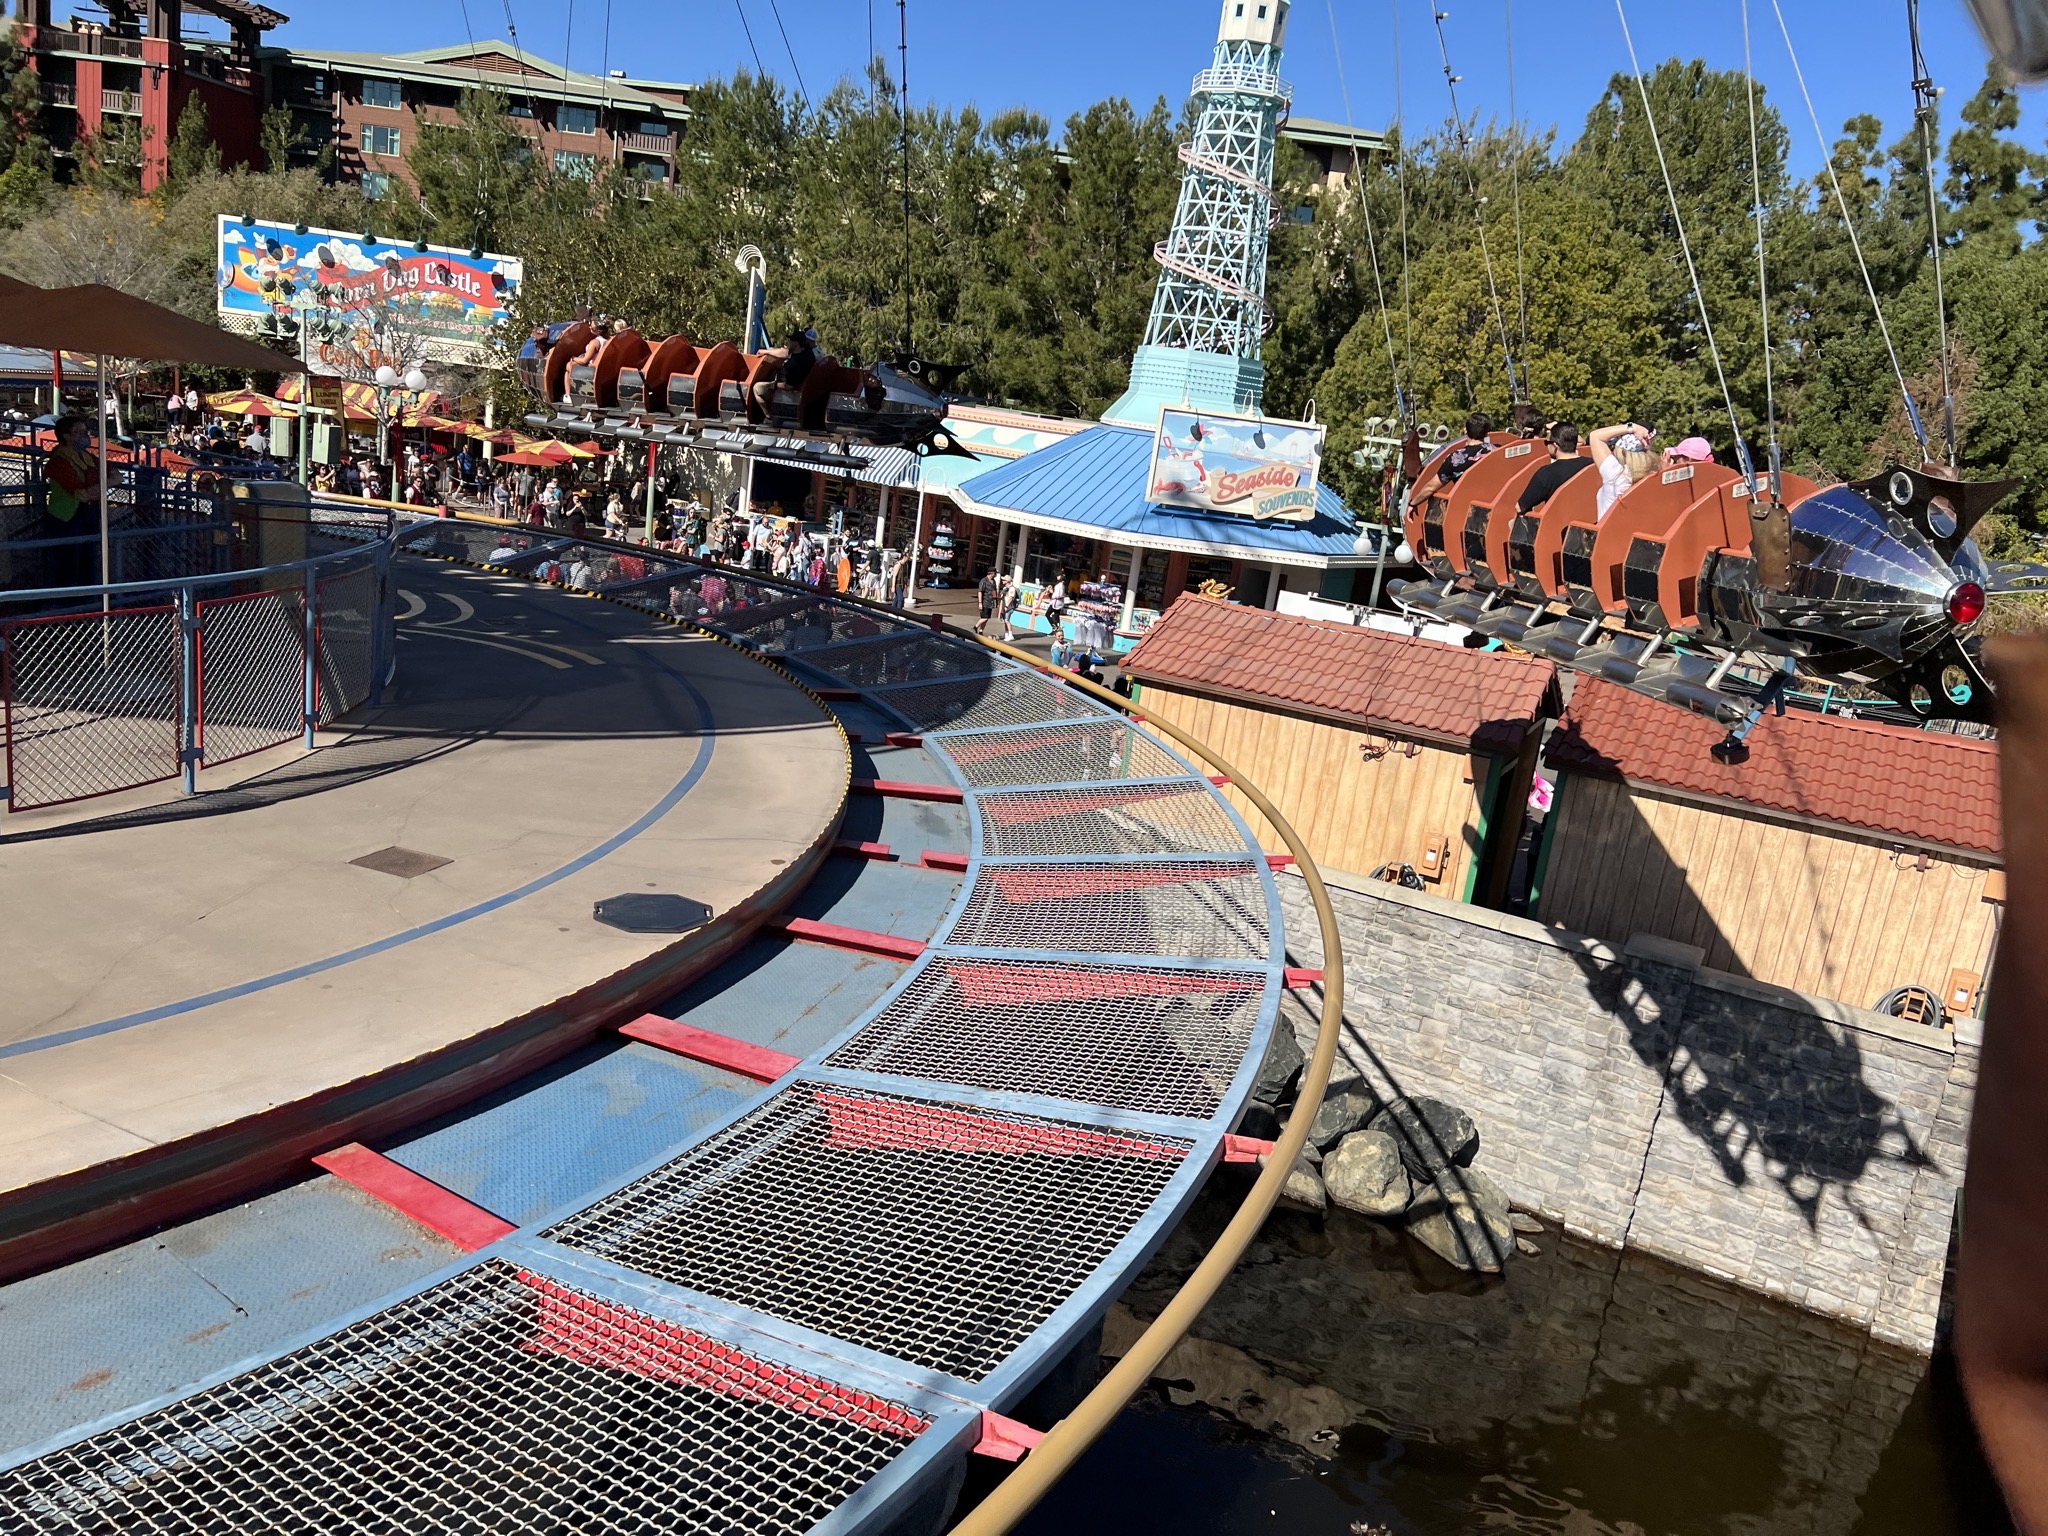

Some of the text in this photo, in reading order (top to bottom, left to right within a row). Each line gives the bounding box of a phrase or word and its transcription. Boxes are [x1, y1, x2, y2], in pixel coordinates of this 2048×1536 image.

[382, 266, 419, 292] Dog
[424, 261, 482, 298] Castle
[447, 321, 473, 334] Dogs
[1217, 467, 1294, 500] Seaside
[1257, 490, 1315, 516] SOUVENIRS
